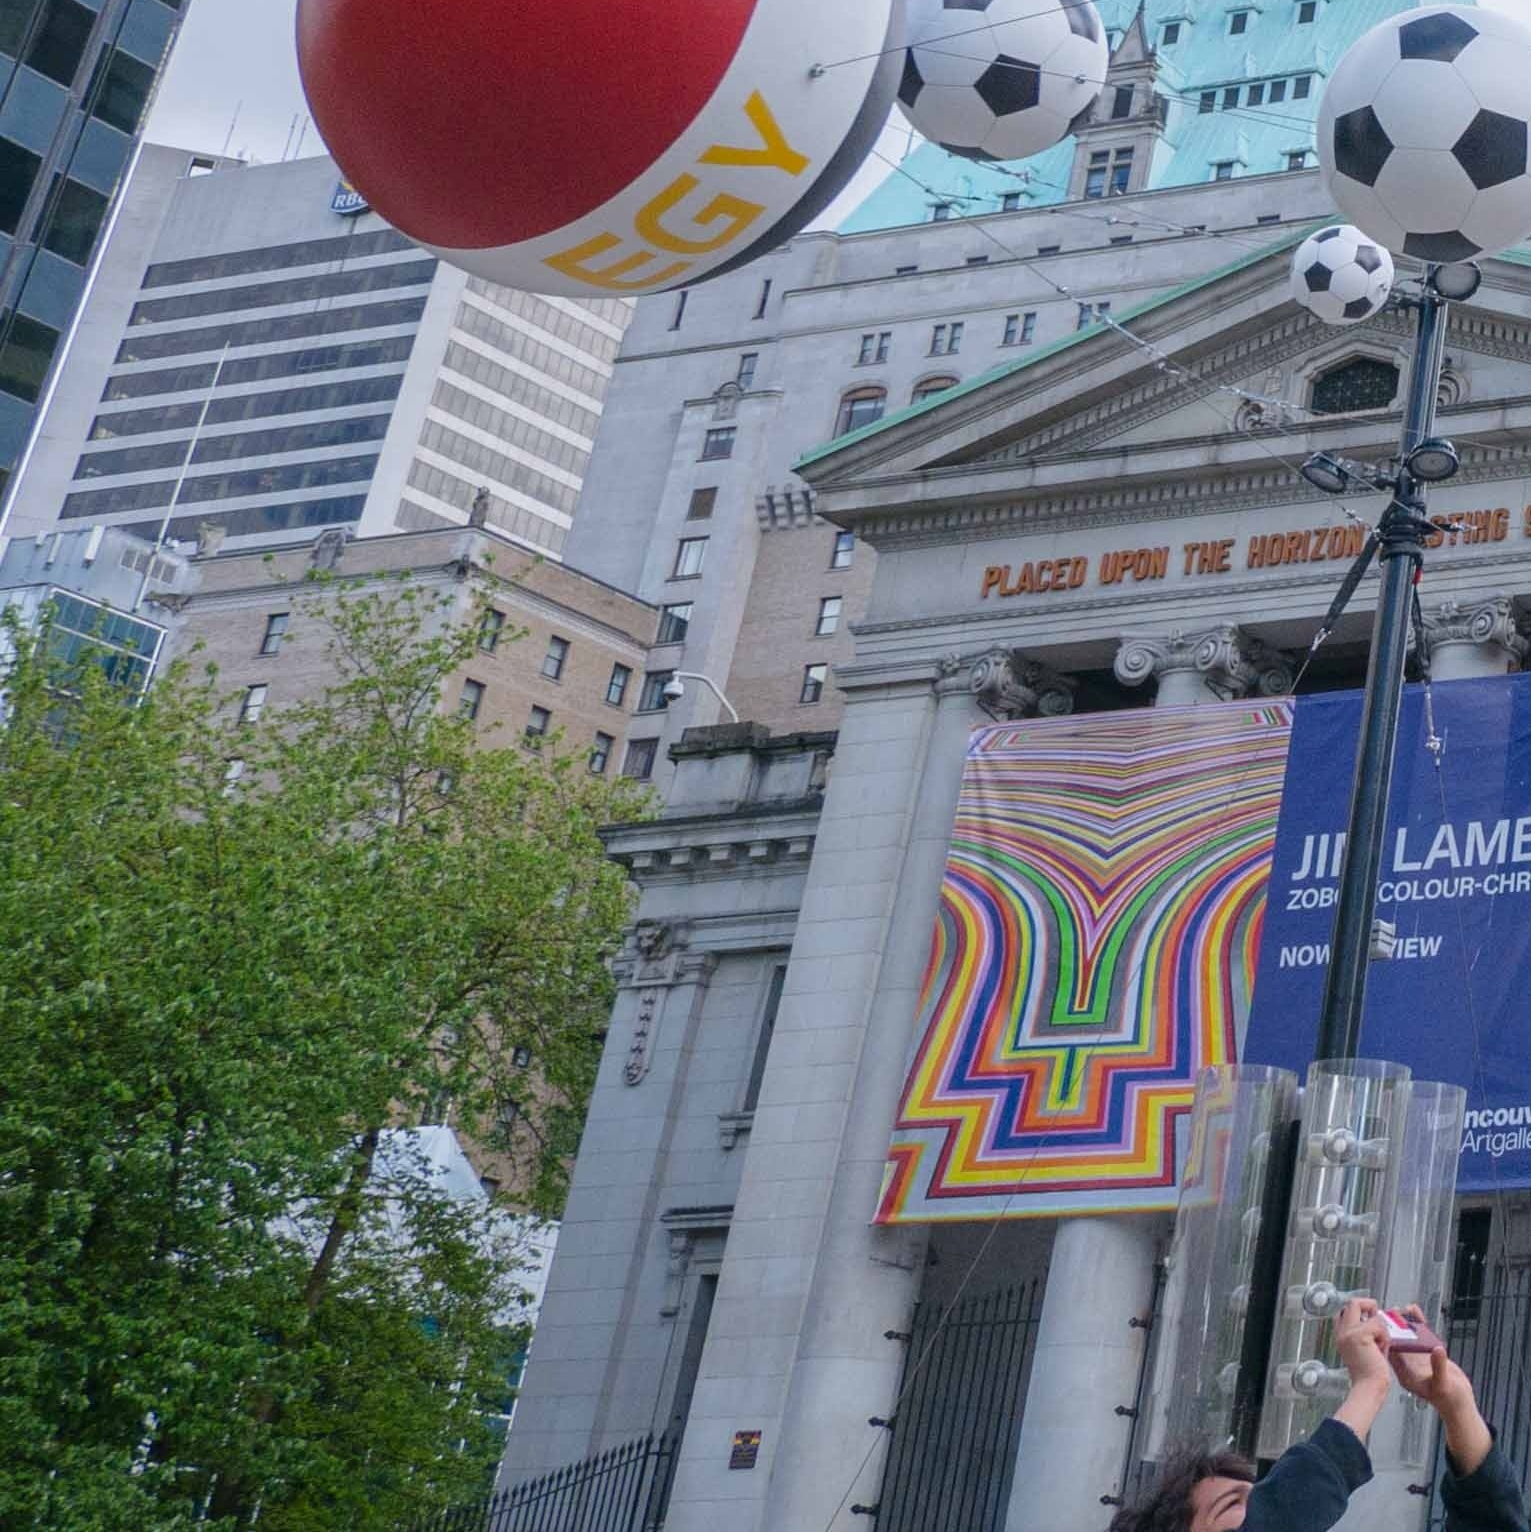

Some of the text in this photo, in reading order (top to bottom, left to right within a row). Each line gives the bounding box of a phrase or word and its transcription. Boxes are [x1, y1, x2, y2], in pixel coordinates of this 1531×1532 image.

[543, 89, 811, 290] EGY
[981, 556, 1089, 598] PLACED
[1099, 546, 1169, 585] UPON
[1183, 538, 1235, 575] THE
[1247, 523, 1365, 569] HORIZON
